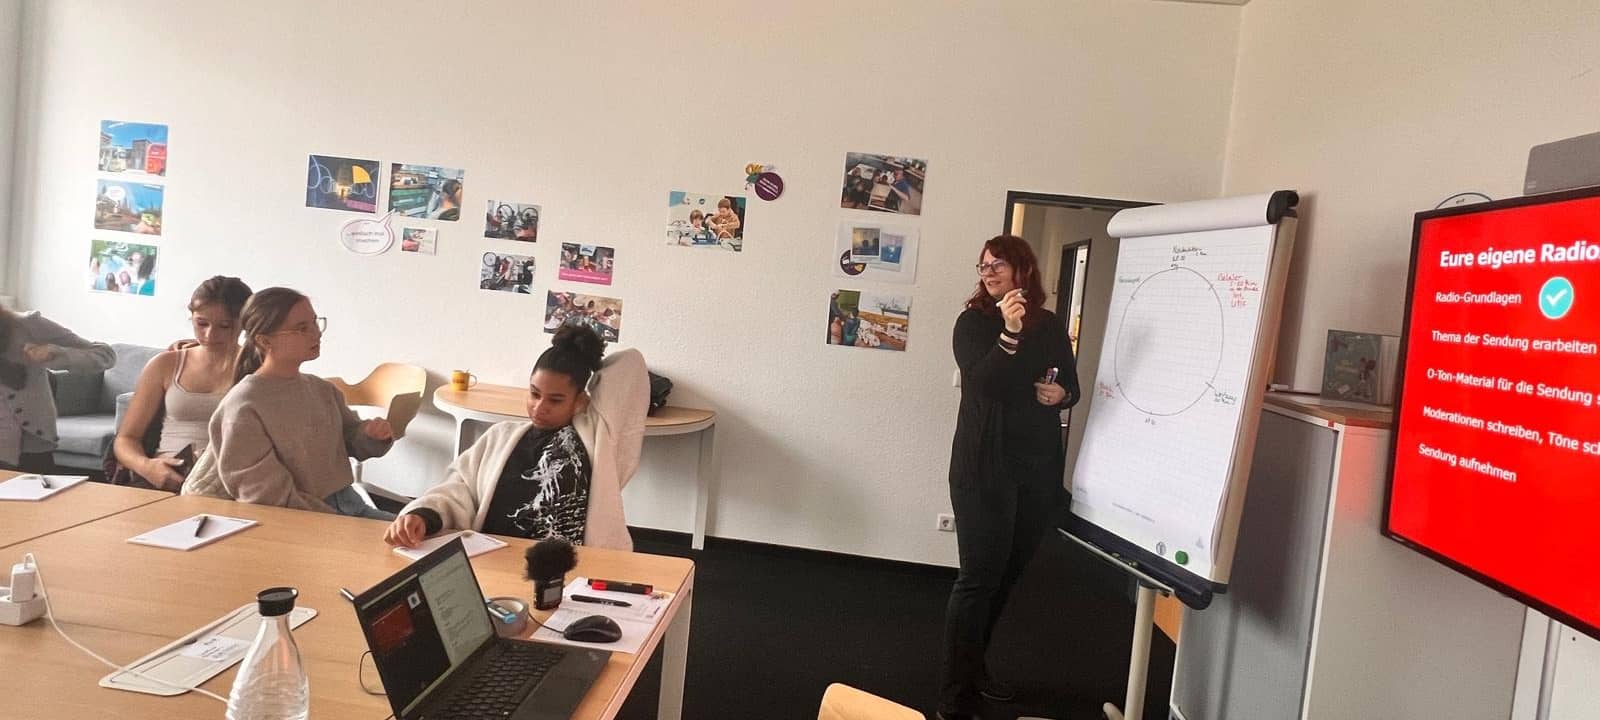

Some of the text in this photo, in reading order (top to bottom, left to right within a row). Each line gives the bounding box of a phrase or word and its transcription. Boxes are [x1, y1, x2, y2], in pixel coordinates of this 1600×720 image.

[1439, 239, 1600, 270] Eure eigene Radio
[1435, 291, 1522, 307] Radio-Grundlagen
[1431, 329, 1598, 355] Thema der Sendung erarbeiten
[1426, 367, 1496, 389] O-Ton-Material
[1496, 377, 1514, 392] für
[1515, 380, 1534, 395] die
[1536, 383, 1594, 407] Sendung
[1422, 405, 1485, 430] Moderationen
[1486, 420, 1544, 445] schreiben,
[1547, 431, 1580, 451] Töne
[1418, 442, 1517, 483] Sendung aufnehmen
